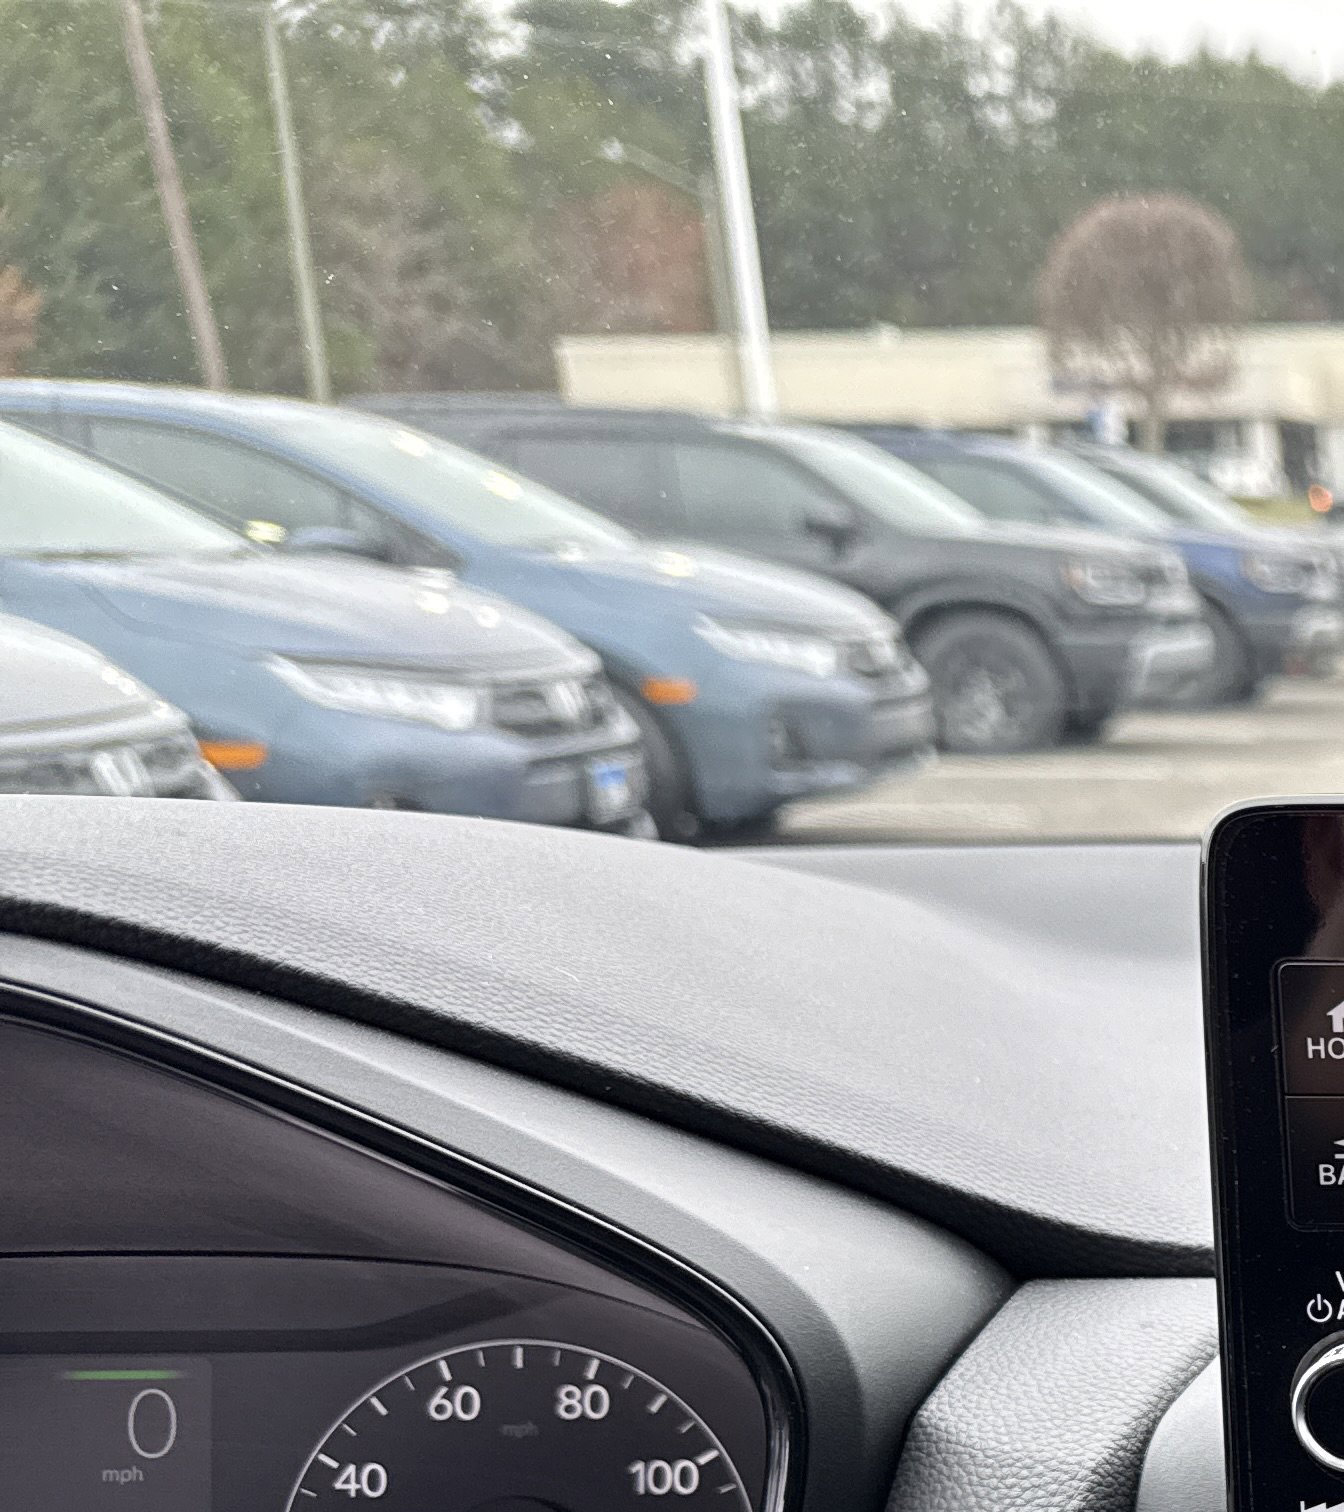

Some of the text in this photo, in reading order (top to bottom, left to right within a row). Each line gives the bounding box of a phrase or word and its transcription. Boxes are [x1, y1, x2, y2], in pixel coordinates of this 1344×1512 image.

[427, 1385, 483, 1421] 60
[555, 1385, 611, 1421] 80
[127, 1388, 178, 1460] 0
[101, 1465, 145, 1485] mph
[333, 1463, 389, 1499] 40
[630, 1459, 700, 1496] 100
